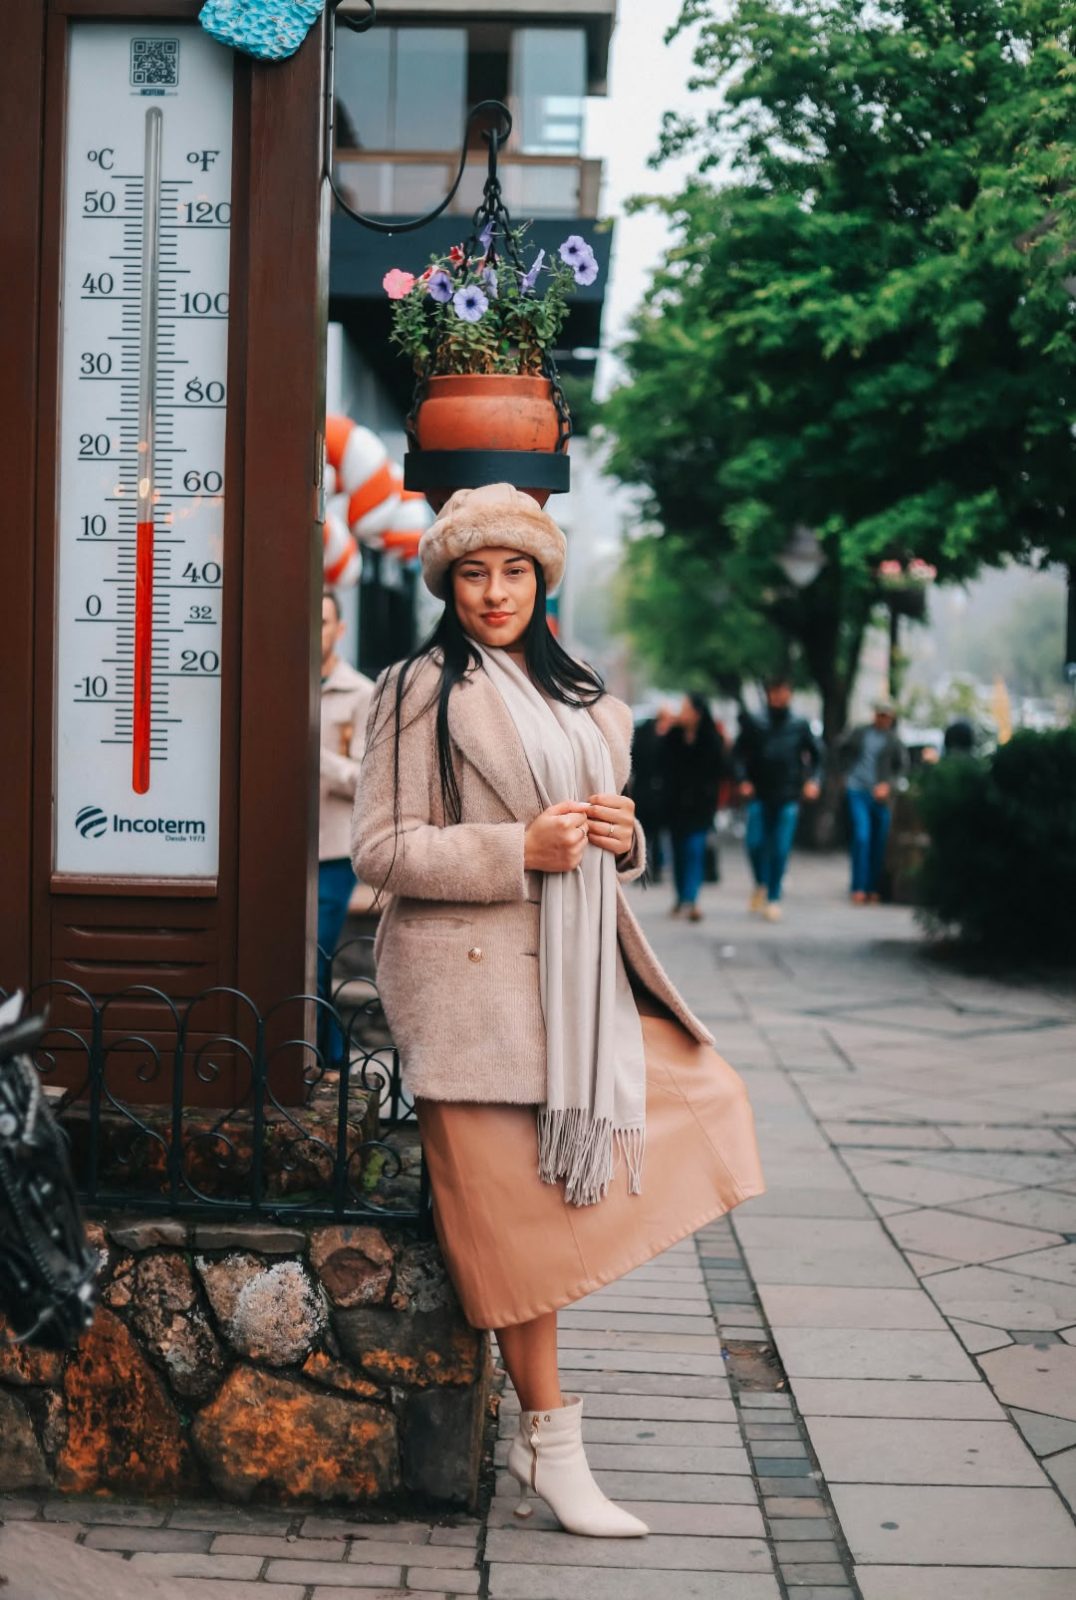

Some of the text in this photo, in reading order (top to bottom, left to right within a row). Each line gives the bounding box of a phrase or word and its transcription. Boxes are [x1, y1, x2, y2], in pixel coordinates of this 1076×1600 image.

[83, 190, 116, 213] 50
[184, 201, 231, 224] 120
[82, 272, 114, 294] 40
[180, 292, 229, 314] 100
[80, 352, 112, 375] 30
[184, 376, 225, 403] 80
[79, 433, 111, 456] 20
[183, 470, 223, 492] 60
[81, 514, 107, 536] 10
[182, 562, 221, 583] 40
[86, 594, 102, 616] 0
[189, 605, 212, 619] 32
[180, 650, 219, 672] 20
[74, 675, 108, 698] -10
[113, 814, 205, 834] Incoterm
